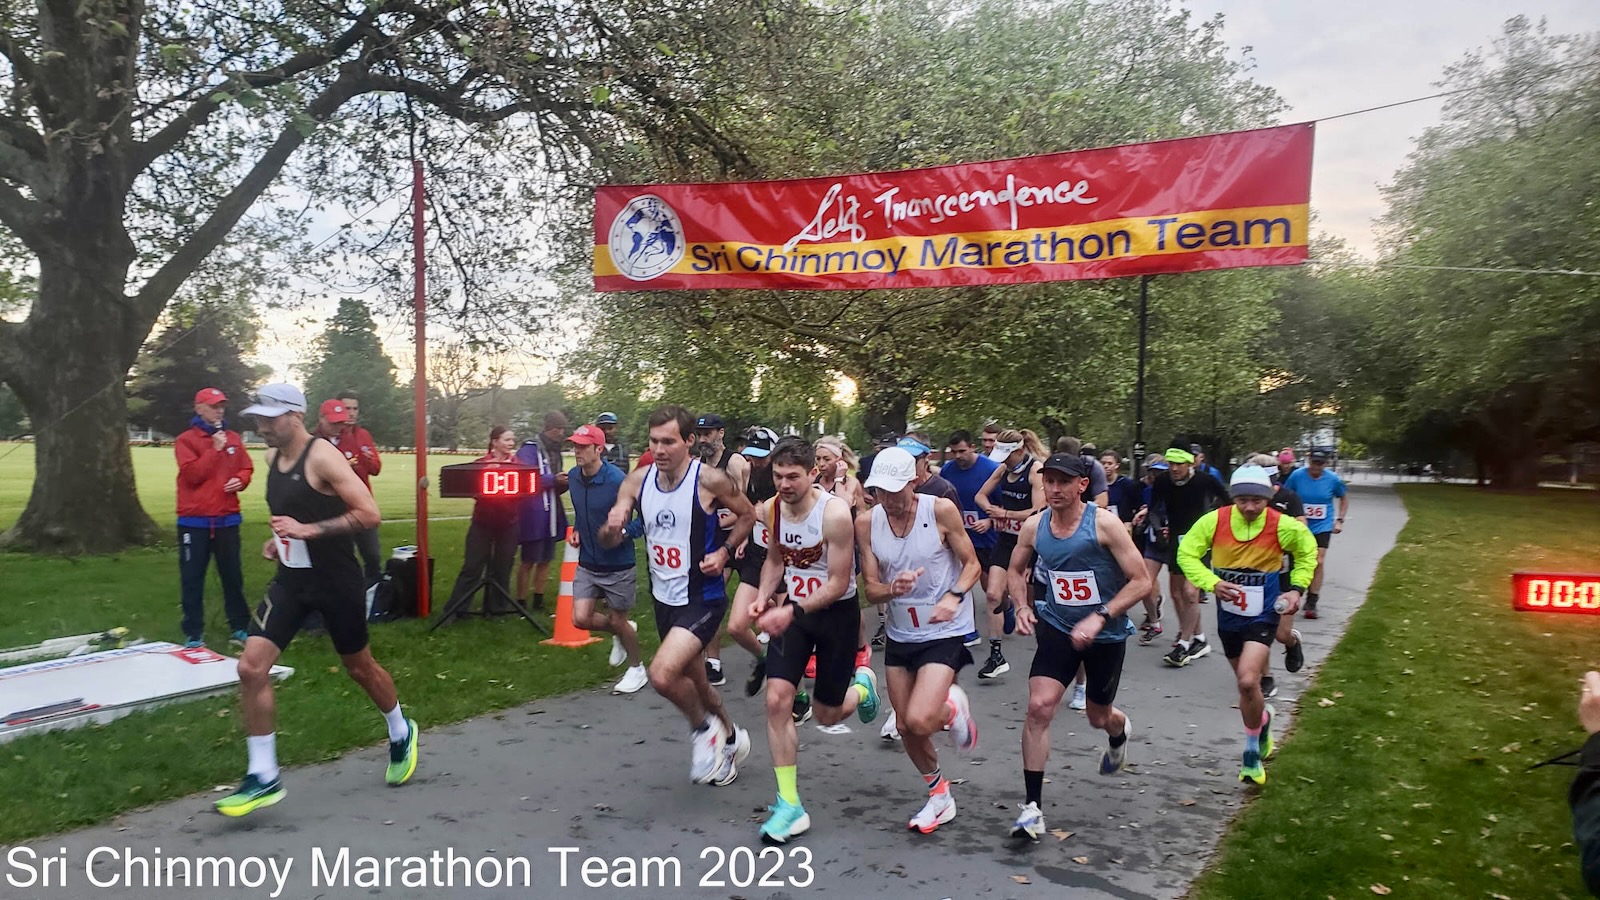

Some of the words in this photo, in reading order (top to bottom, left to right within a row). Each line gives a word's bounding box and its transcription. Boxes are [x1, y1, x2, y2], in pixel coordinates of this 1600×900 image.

[691, 244, 732, 272] Sri
[736, 245, 907, 277] Chinmoy
[920, 229, 1131, 267] Marathon
[1147, 217, 1291, 250] Team
[785, 533, 802, 545] UC
[652, 545, 681, 569] 38
[792, 575, 822, 598] 20
[1056, 578, 1092, 601] 35
[1233, 592, 1248, 611] 4
[907, 607, 920, 628] 1
